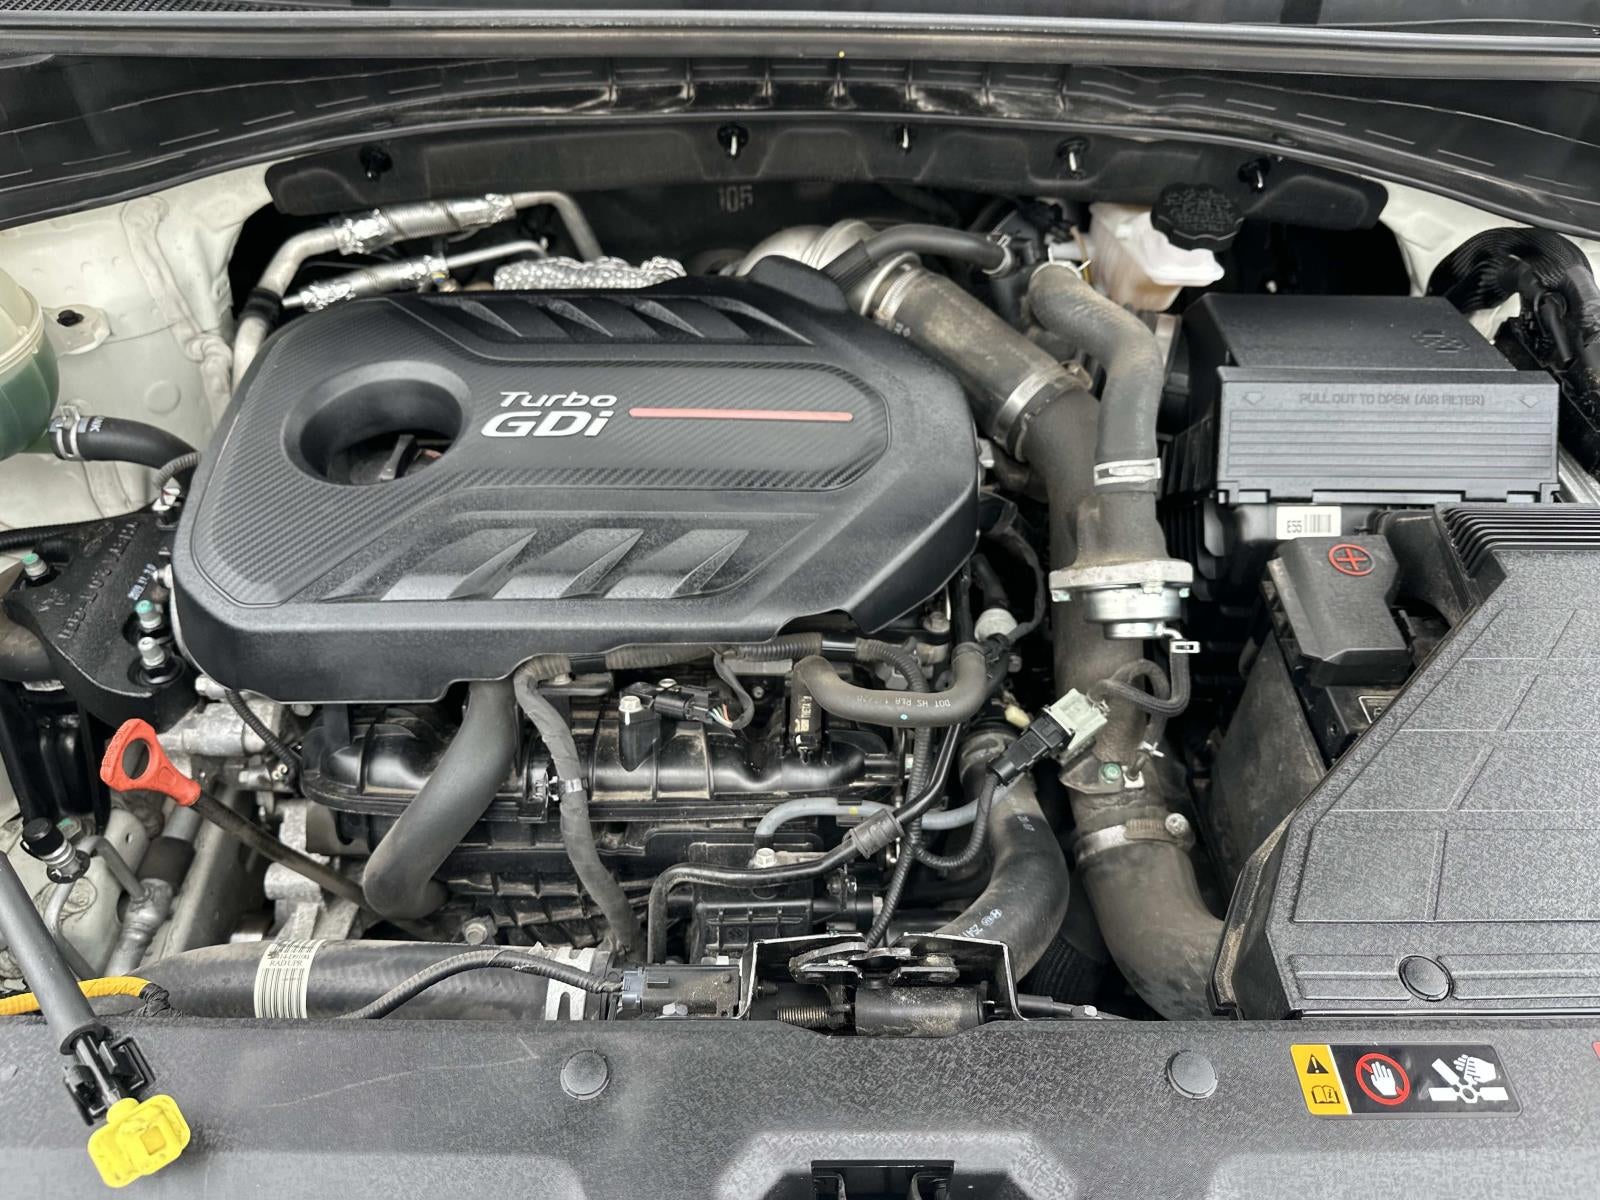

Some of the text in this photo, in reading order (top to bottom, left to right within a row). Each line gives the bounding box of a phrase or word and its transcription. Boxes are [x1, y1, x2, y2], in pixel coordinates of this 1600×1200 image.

[499, 391, 618, 408] Turbo
[1299, 393, 1485, 407] PULL OUT TO OPEN (AIR FILTER)
[480, 409, 616, 438] GDi
[916, 698, 928, 708] HS
[934, 699, 952, 708] DOT
